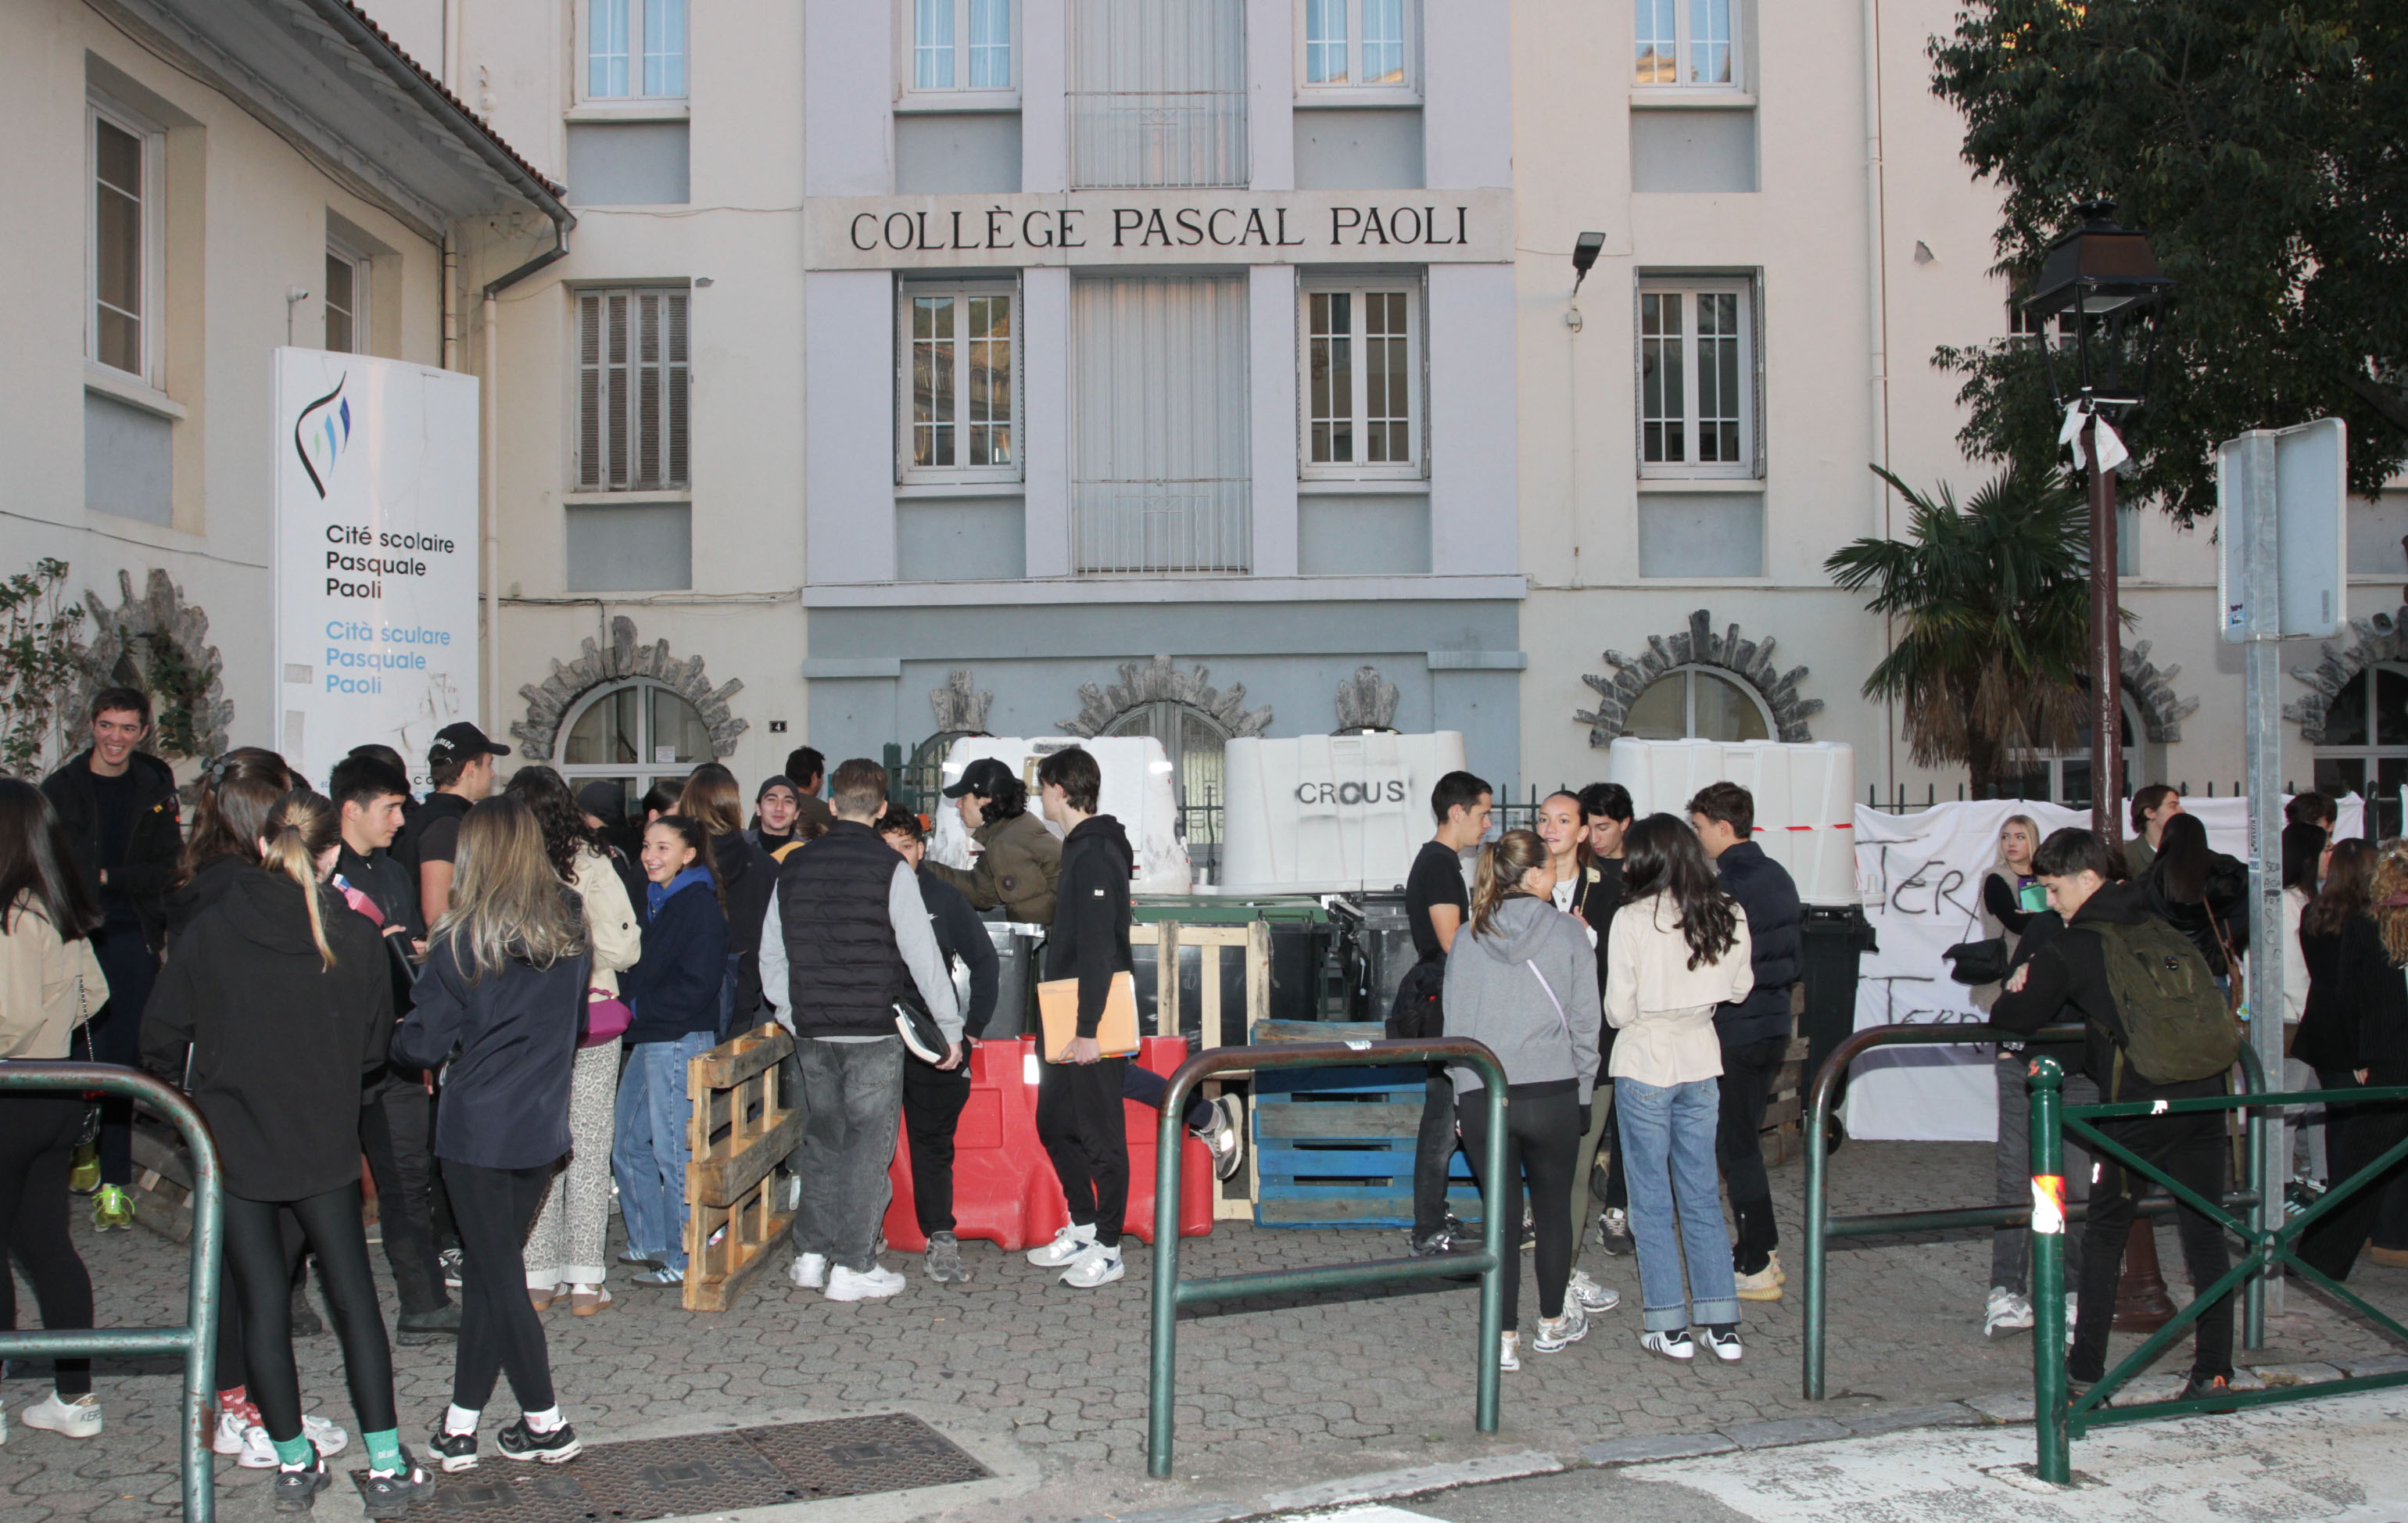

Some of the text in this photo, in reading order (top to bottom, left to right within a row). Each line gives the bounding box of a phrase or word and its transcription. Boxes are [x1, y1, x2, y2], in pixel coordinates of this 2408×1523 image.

[851, 205, 1468, 251] COLLÈGE PASCAL PAOLI
[326, 525, 454, 554] Cité scolaire
[326, 551, 426, 577] Pasquale
[326, 578, 382, 599] Paoli
[325, 621, 451, 646] Cità sculare
[326, 647, 427, 672] Pasquale
[326, 674, 382, 694] Paoli
[775, 722, 781, 732] 4
[1297, 780, 1405, 805] CROUS
